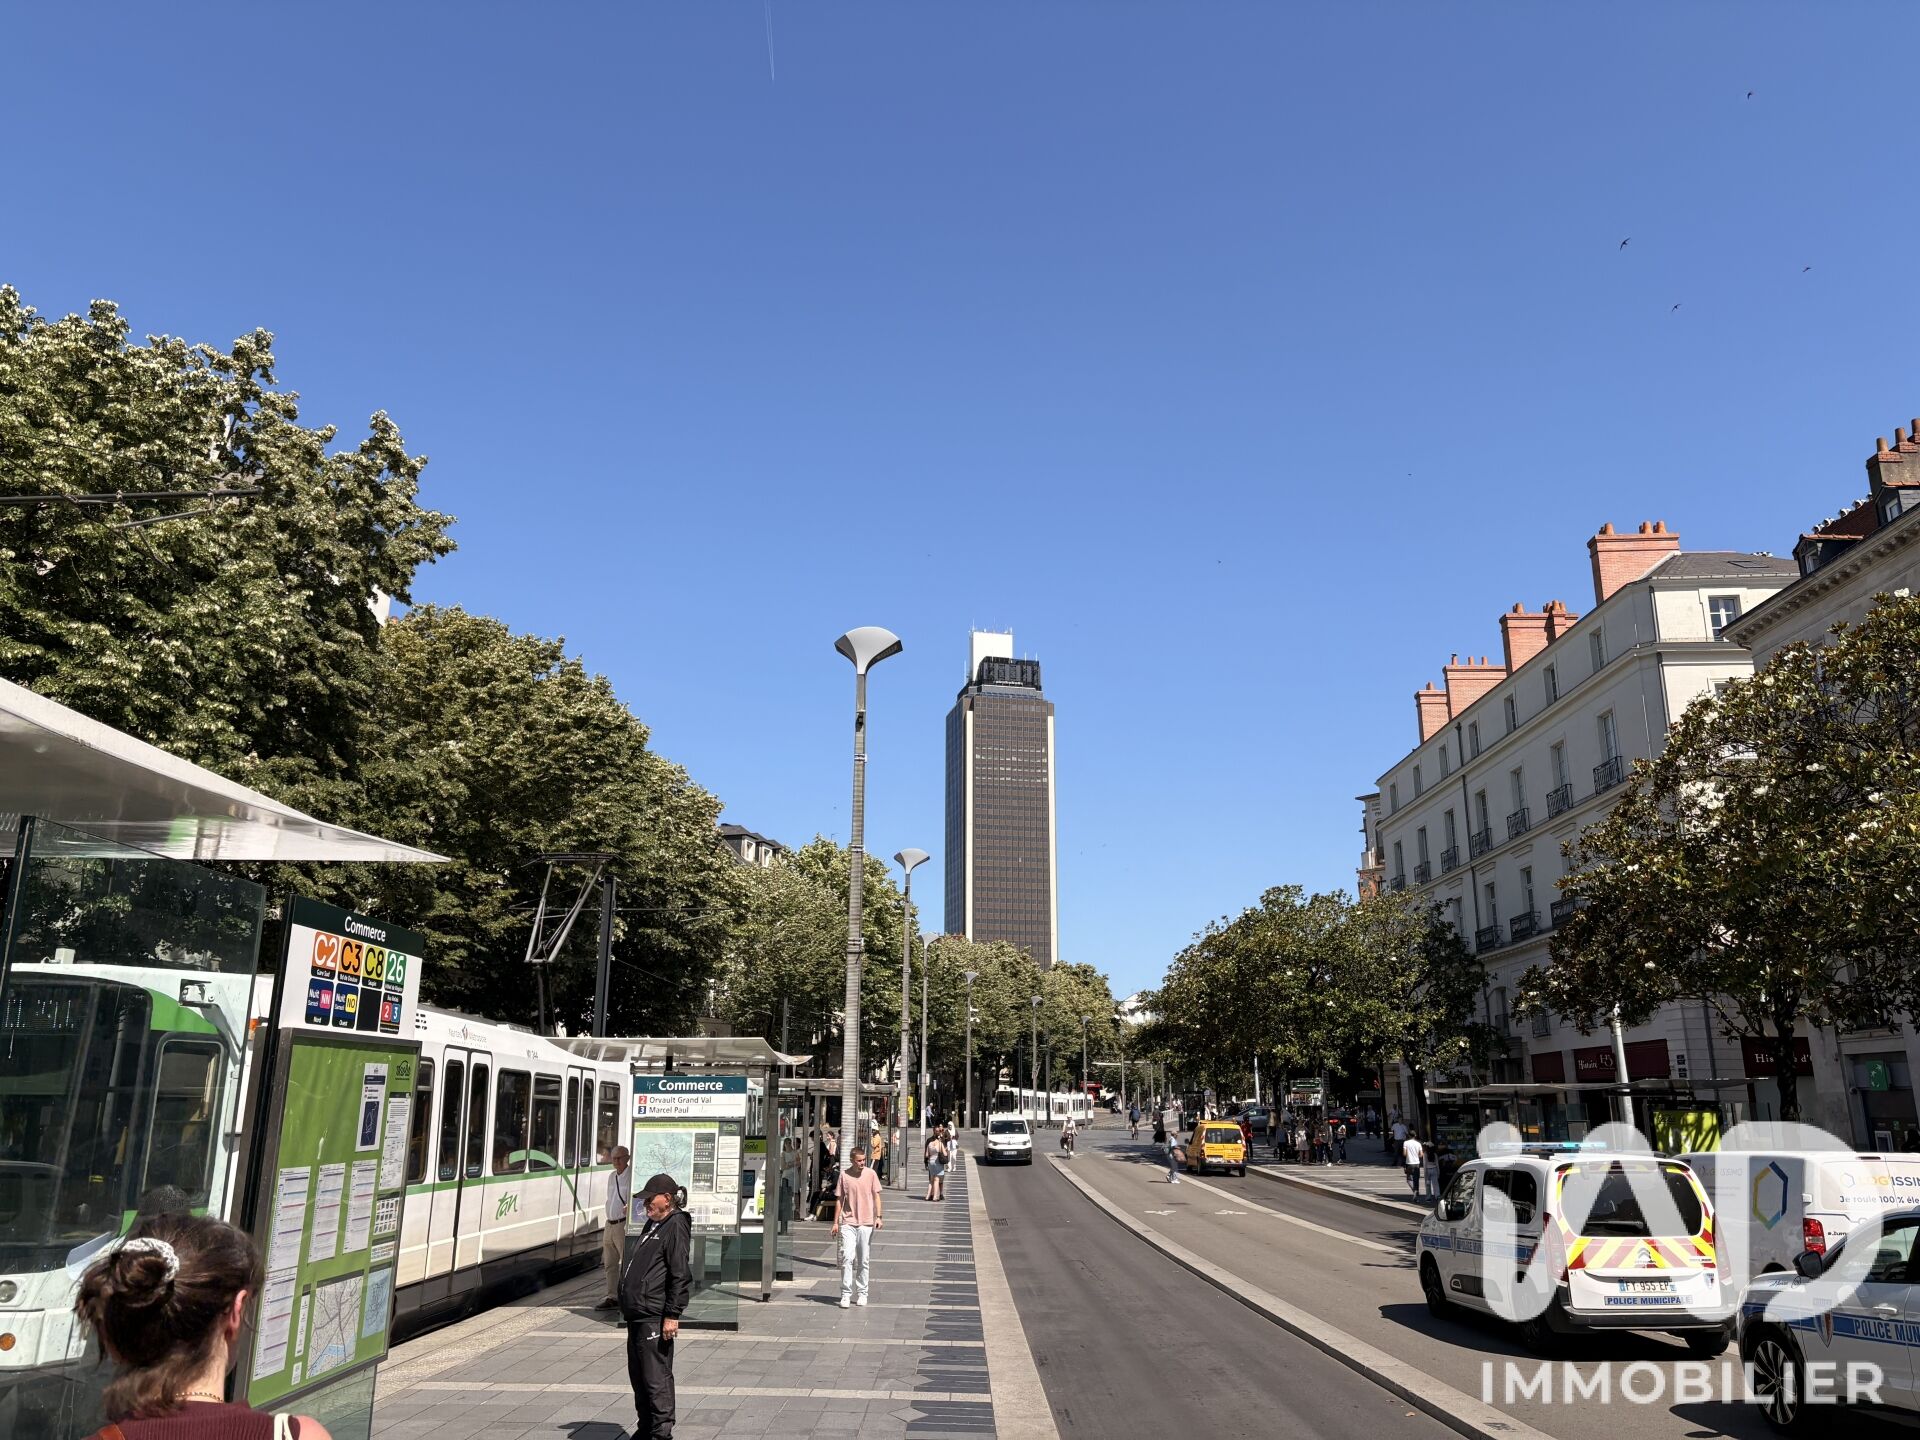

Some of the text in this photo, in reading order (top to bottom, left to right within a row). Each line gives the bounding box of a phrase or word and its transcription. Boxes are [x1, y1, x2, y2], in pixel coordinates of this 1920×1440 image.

[344, 916, 386, 942] Commerce
[314, 934, 337, 969] C2
[340, 941, 362, 973] C3
[364, 947, 384, 978] C8
[387, 953, 404, 983] 26
[309, 989, 330, 1005] Nuit NN
[336, 994, 356, 1009] Nuit NO
[384, 1005, 398, 1019] 2 3
[658, 1080, 724, 1091] Commerce
[649, 1096, 676, 1104] Orvault
[677, 1096, 699, 1104] Grand
[700, 1096, 712, 1104] Val
[640, 1106, 645, 1114] 3
[1853, 1195, 1877, 1203] roule
[1879, 1195, 1895, 1203] 100
[1607, 1297, 1638, 1305] POLICE
[1855, 1318, 1893, 1340] POLICE
